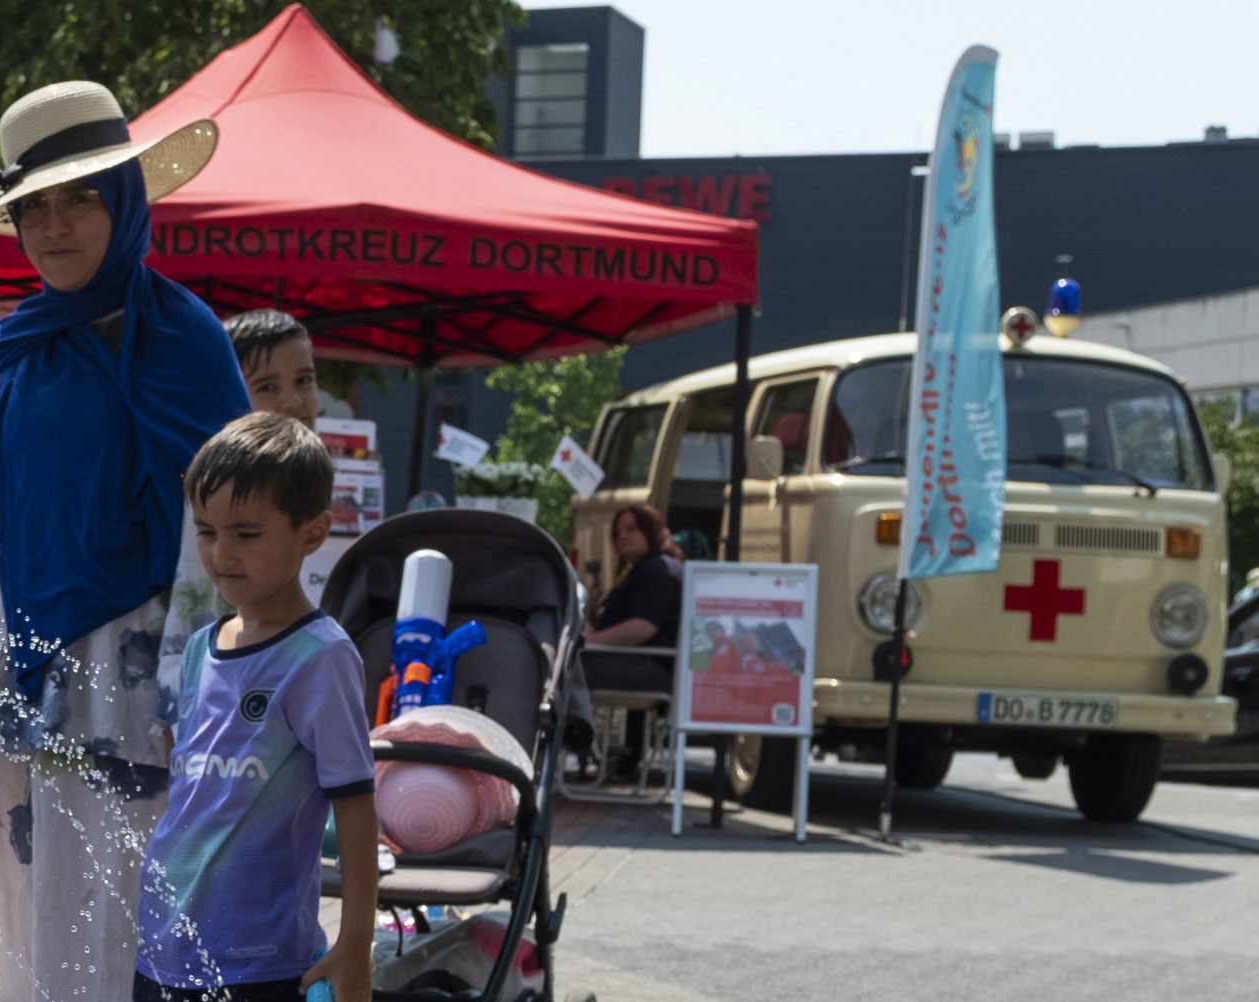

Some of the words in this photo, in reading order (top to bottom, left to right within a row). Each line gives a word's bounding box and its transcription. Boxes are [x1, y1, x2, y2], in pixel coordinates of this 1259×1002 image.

[469, 237, 720, 287] DORTMUND
[994, 697, 1024, 720] DO
[1039, 699, 1054, 722] B
[1059, 701, 1115, 724] 7778
